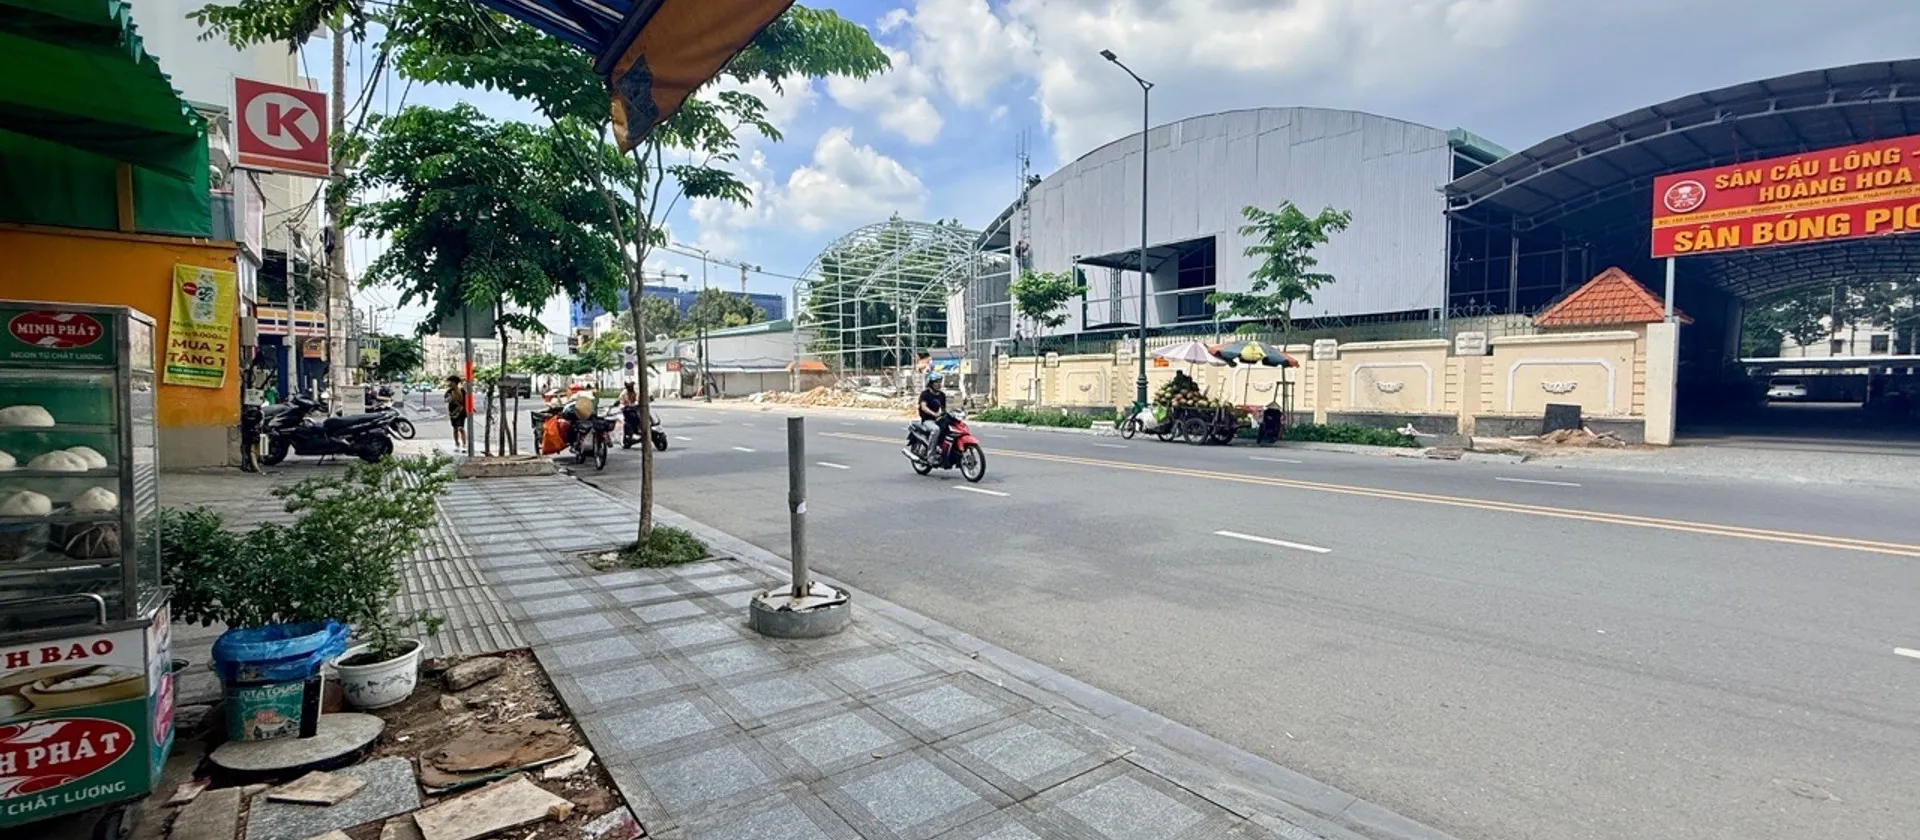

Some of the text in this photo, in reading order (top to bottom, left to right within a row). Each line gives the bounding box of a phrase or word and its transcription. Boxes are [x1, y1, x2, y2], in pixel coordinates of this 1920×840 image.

[1714, 168, 1763, 190] SÂN
[1770, 158, 1820, 181] CẦU
[1829, 147, 1901, 173] LÔNG
[1759, 166, 1913, 202] HOÀNG HOA
[1673, 223, 1740, 252] SÂN
[1752, 212, 1851, 245] BÓNG
[16, 322, 97, 336] MINH PHÁT
[171, 338, 226, 353] MUA 2
[218, 357, 226, 367] 1
[40, 639, 114, 665] BAO
[25, 731, 121, 770] PHÁT
[64, 780, 127, 804] LƯỢNG
